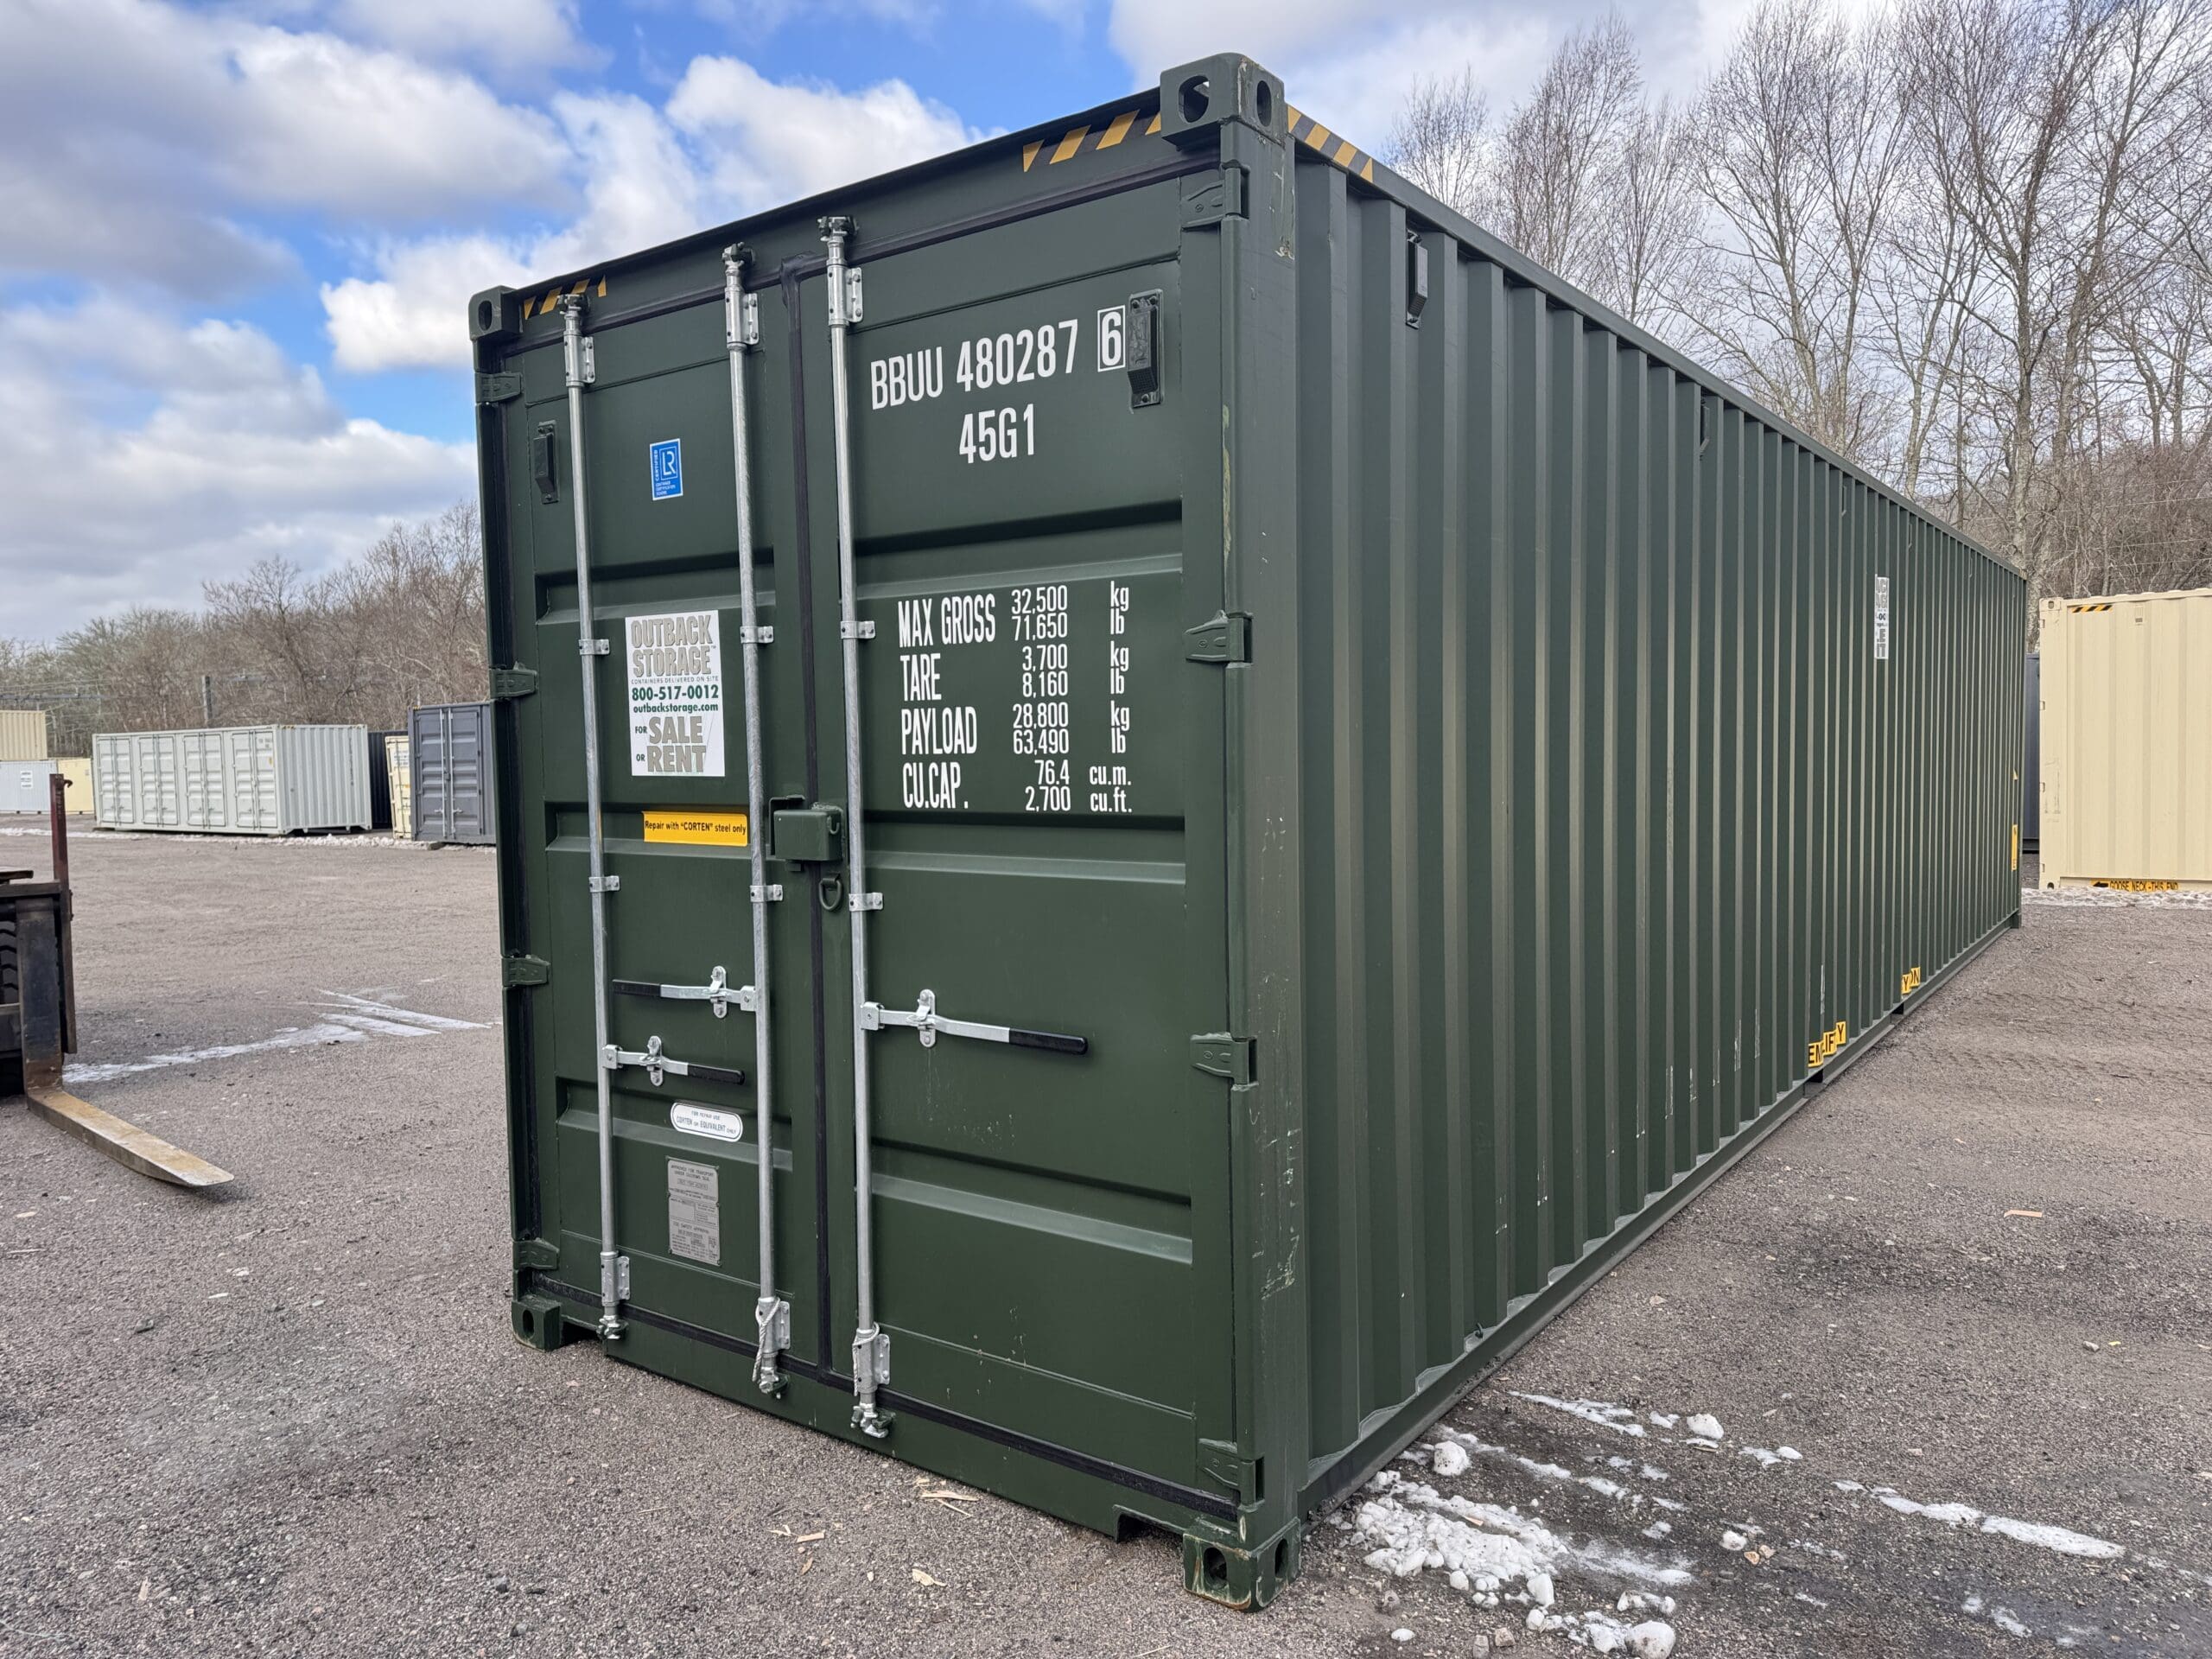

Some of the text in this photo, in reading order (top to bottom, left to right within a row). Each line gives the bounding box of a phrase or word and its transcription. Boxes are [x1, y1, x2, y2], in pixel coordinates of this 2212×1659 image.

[871, 311, 1122, 410] BBUU 480287 6
[959, 404, 1035, 464] 45G1
[662, 451, 676, 475] LR
[898, 581, 1129, 648] MAX GROSS 32,500 kg
[1012, 608, 1125, 641] 71,650 lb
[631, 614, 714, 648] OUTBACK
[632, 645, 711, 678] STORAGE
[900, 640, 1129, 702] TARE 3,700 kg
[632, 683, 719, 701] 800-517-0012
[1022, 668, 1125, 698] 8,160 lb
[633, 702, 719, 714] outbackstorage.com
[649, 715, 703, 744] SALE
[901, 700, 1130, 755] PAYLOAD 28,800 kg
[1013, 728, 1126, 755] 63,490 lb
[646, 745, 707, 772] RENT
[1034, 760, 1070, 785] 76.4
[1089, 766, 1132, 786] cu.m.
[1025, 785, 1133, 813] 2,700 cu.ft.
[645, 820, 664, 831] Repair
[665, 821, 679, 830] with
[715, 823, 731, 832] steel
[732, 823, 747, 835] only
[2109, 880, 2130, 891] GOOSE
[677, 1116, 693, 1126] CORTEN
[700, 1120, 726, 1132] EQUIVALENT
